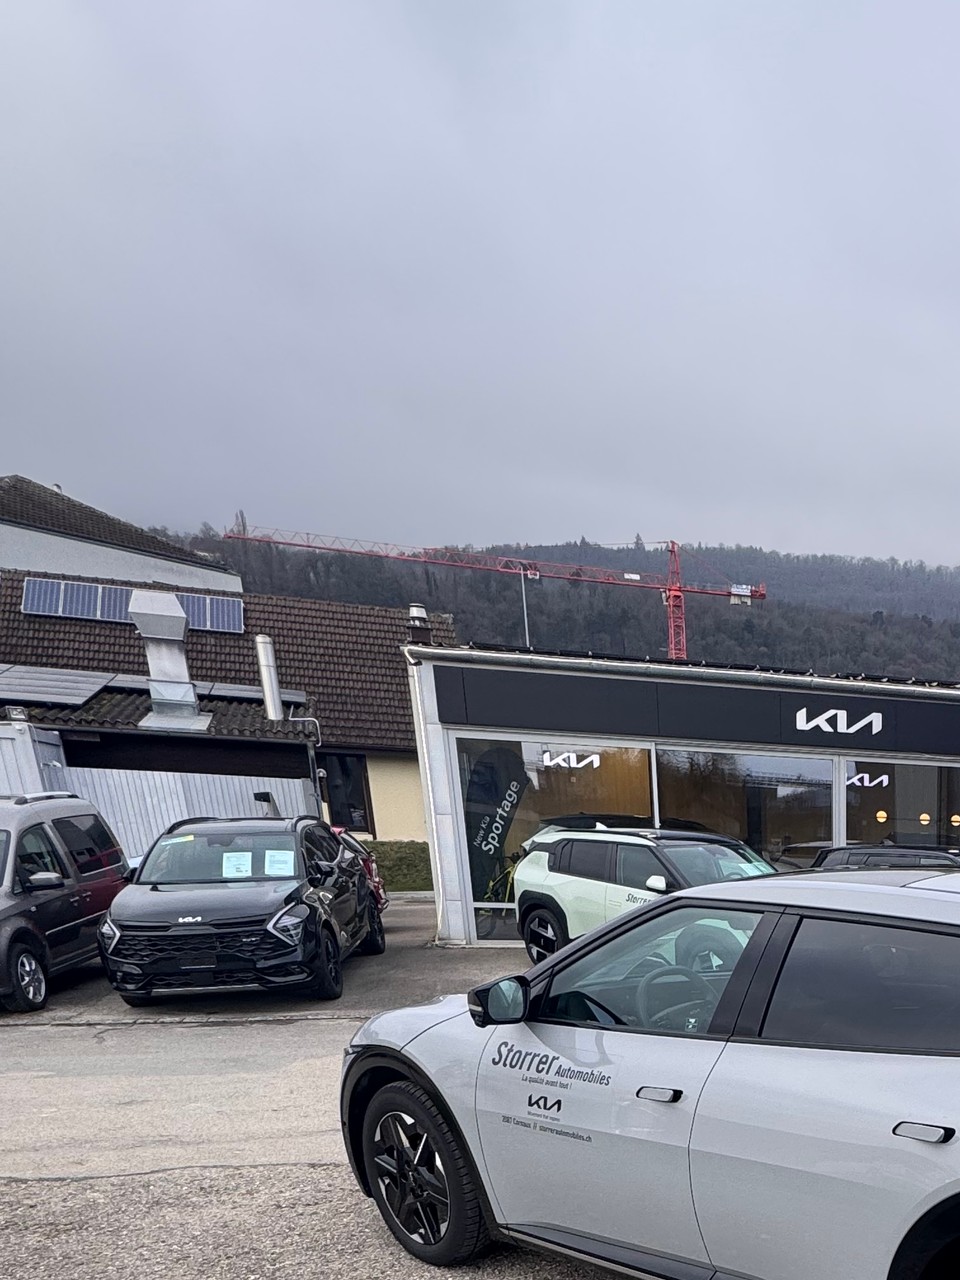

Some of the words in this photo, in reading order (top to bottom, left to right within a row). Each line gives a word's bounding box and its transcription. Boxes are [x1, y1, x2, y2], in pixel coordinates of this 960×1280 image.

[795, 707, 883, 735] KIA
[543, 752, 600, 768] KIA
[481, 781, 520, 855] Sportage
[473, 827, 485, 847] New
[492, 1041, 560, 1075] Storrer
[554, 1064, 612, 1086] Automobiles
[528, 1093, 562, 1113] KIA
